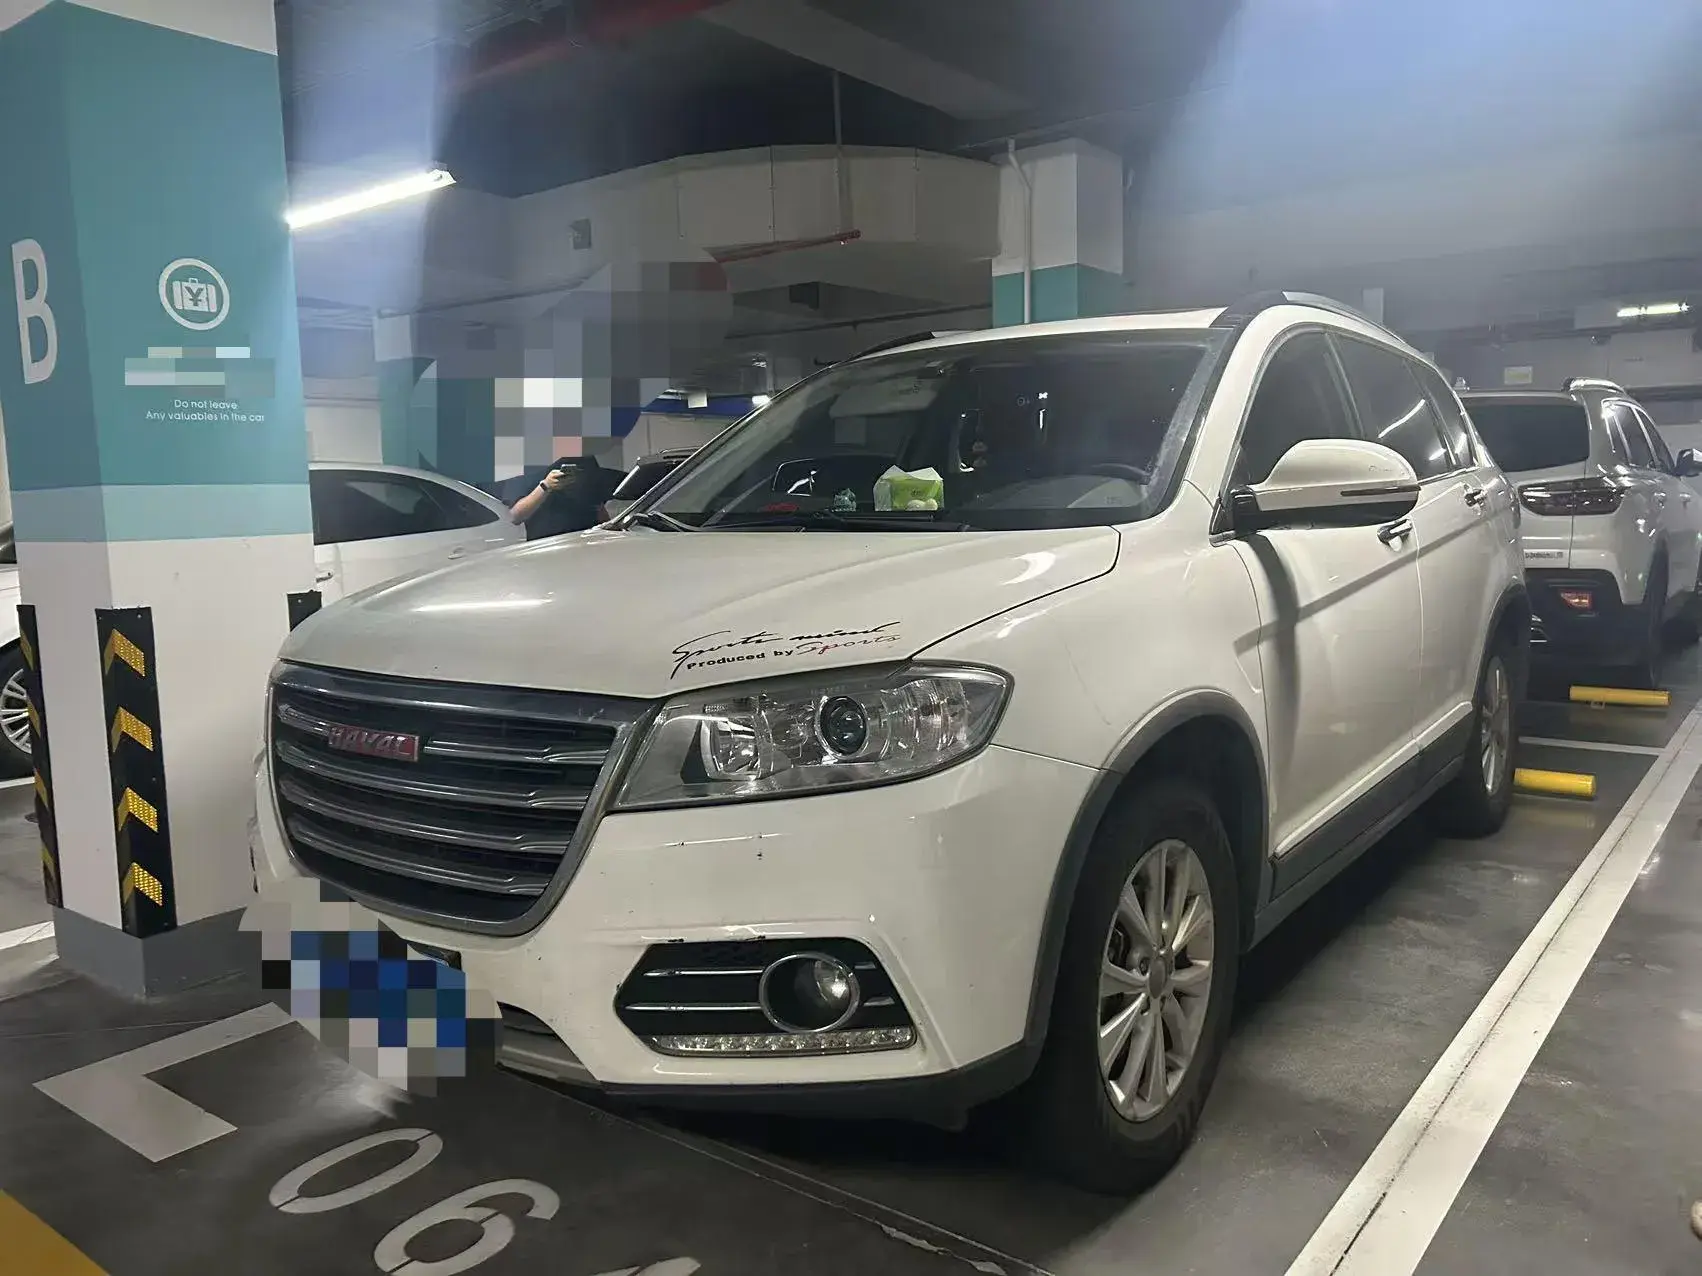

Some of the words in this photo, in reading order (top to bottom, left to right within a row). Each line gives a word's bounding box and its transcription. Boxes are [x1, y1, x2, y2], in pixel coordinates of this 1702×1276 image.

[12, 238, 58, 385] B
[174, 400, 188, 409] Do
[190, 400, 207, 409] not
[209, 400, 238, 410] leave
[146, 411, 165, 421] Any
[168, 412, 218, 421] valuables
[231, 413, 247, 422] the
[686, 652, 766, 670] Produced
